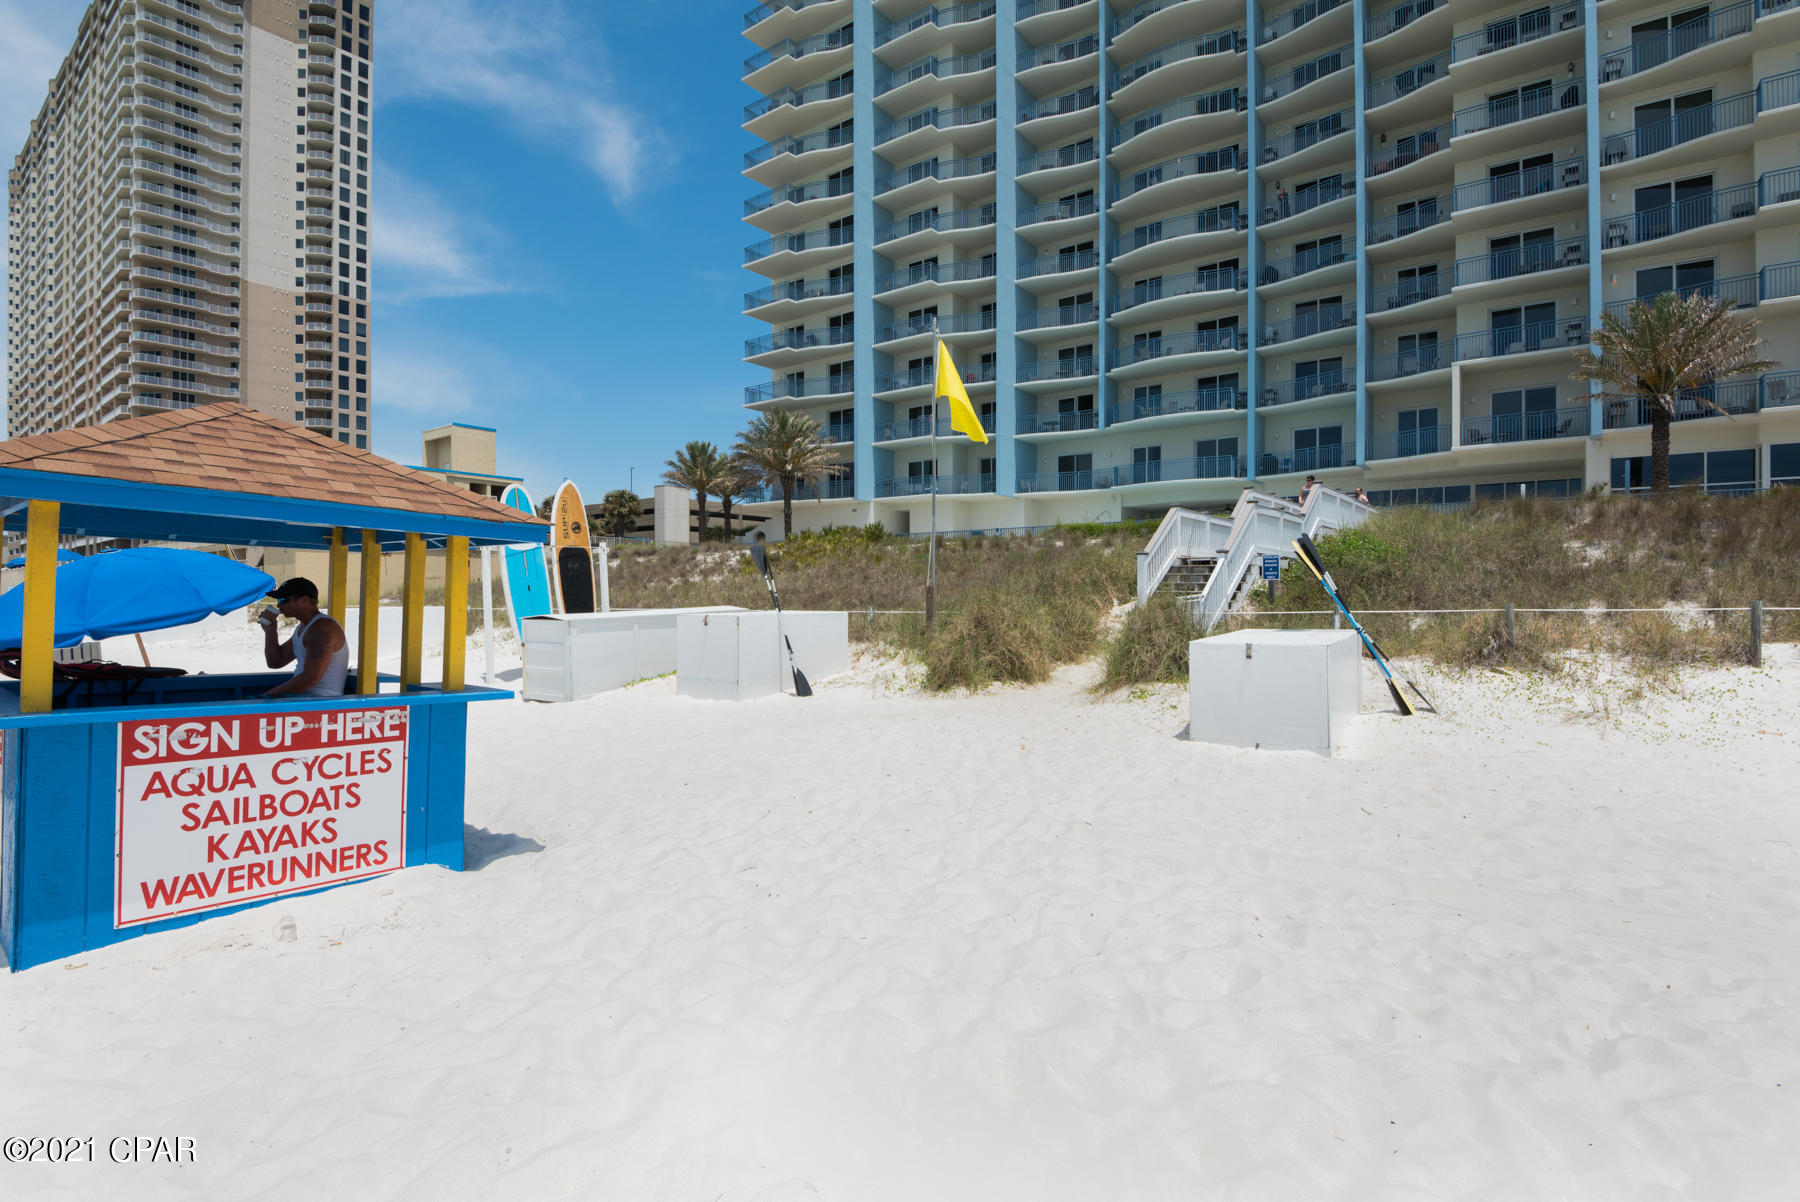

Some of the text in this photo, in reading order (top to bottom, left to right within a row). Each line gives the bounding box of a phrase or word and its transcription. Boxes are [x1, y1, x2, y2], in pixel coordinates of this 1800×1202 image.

[132, 709, 402, 760] SIGN UP HERE
[140, 748, 393, 802] AQUA CYCLES
[180, 782, 361, 832] SAILBOATS
[206, 817, 338, 863] KAYAKS
[140, 839, 389, 910] WAVERUNNERS
